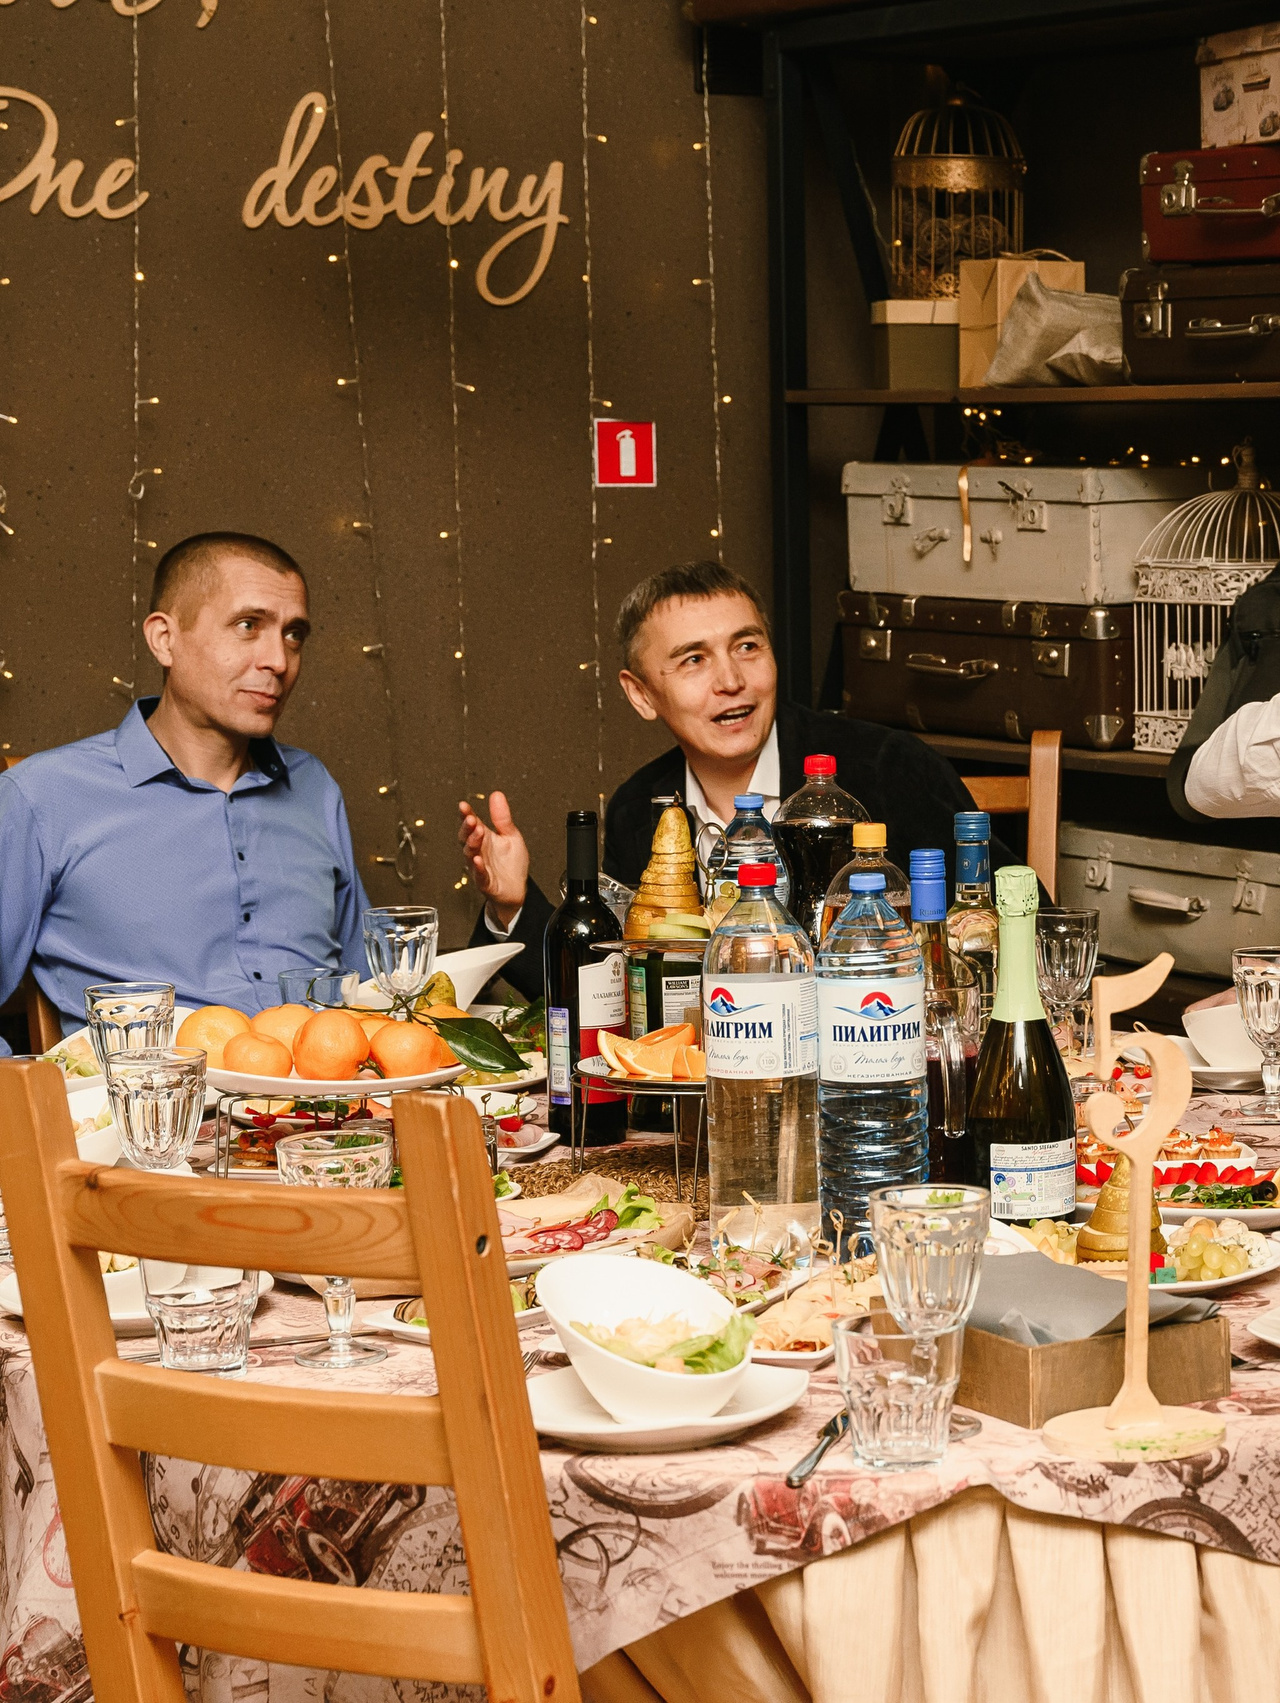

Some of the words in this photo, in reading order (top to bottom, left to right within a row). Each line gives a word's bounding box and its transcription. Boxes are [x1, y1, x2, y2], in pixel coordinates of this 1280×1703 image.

[242, 92, 569, 306] destiny
[832, 1020, 921, 1043] ПИЛИГРИМ
[847, 1070, 912, 1079] НЕГАЗИРОВАННАЯ
